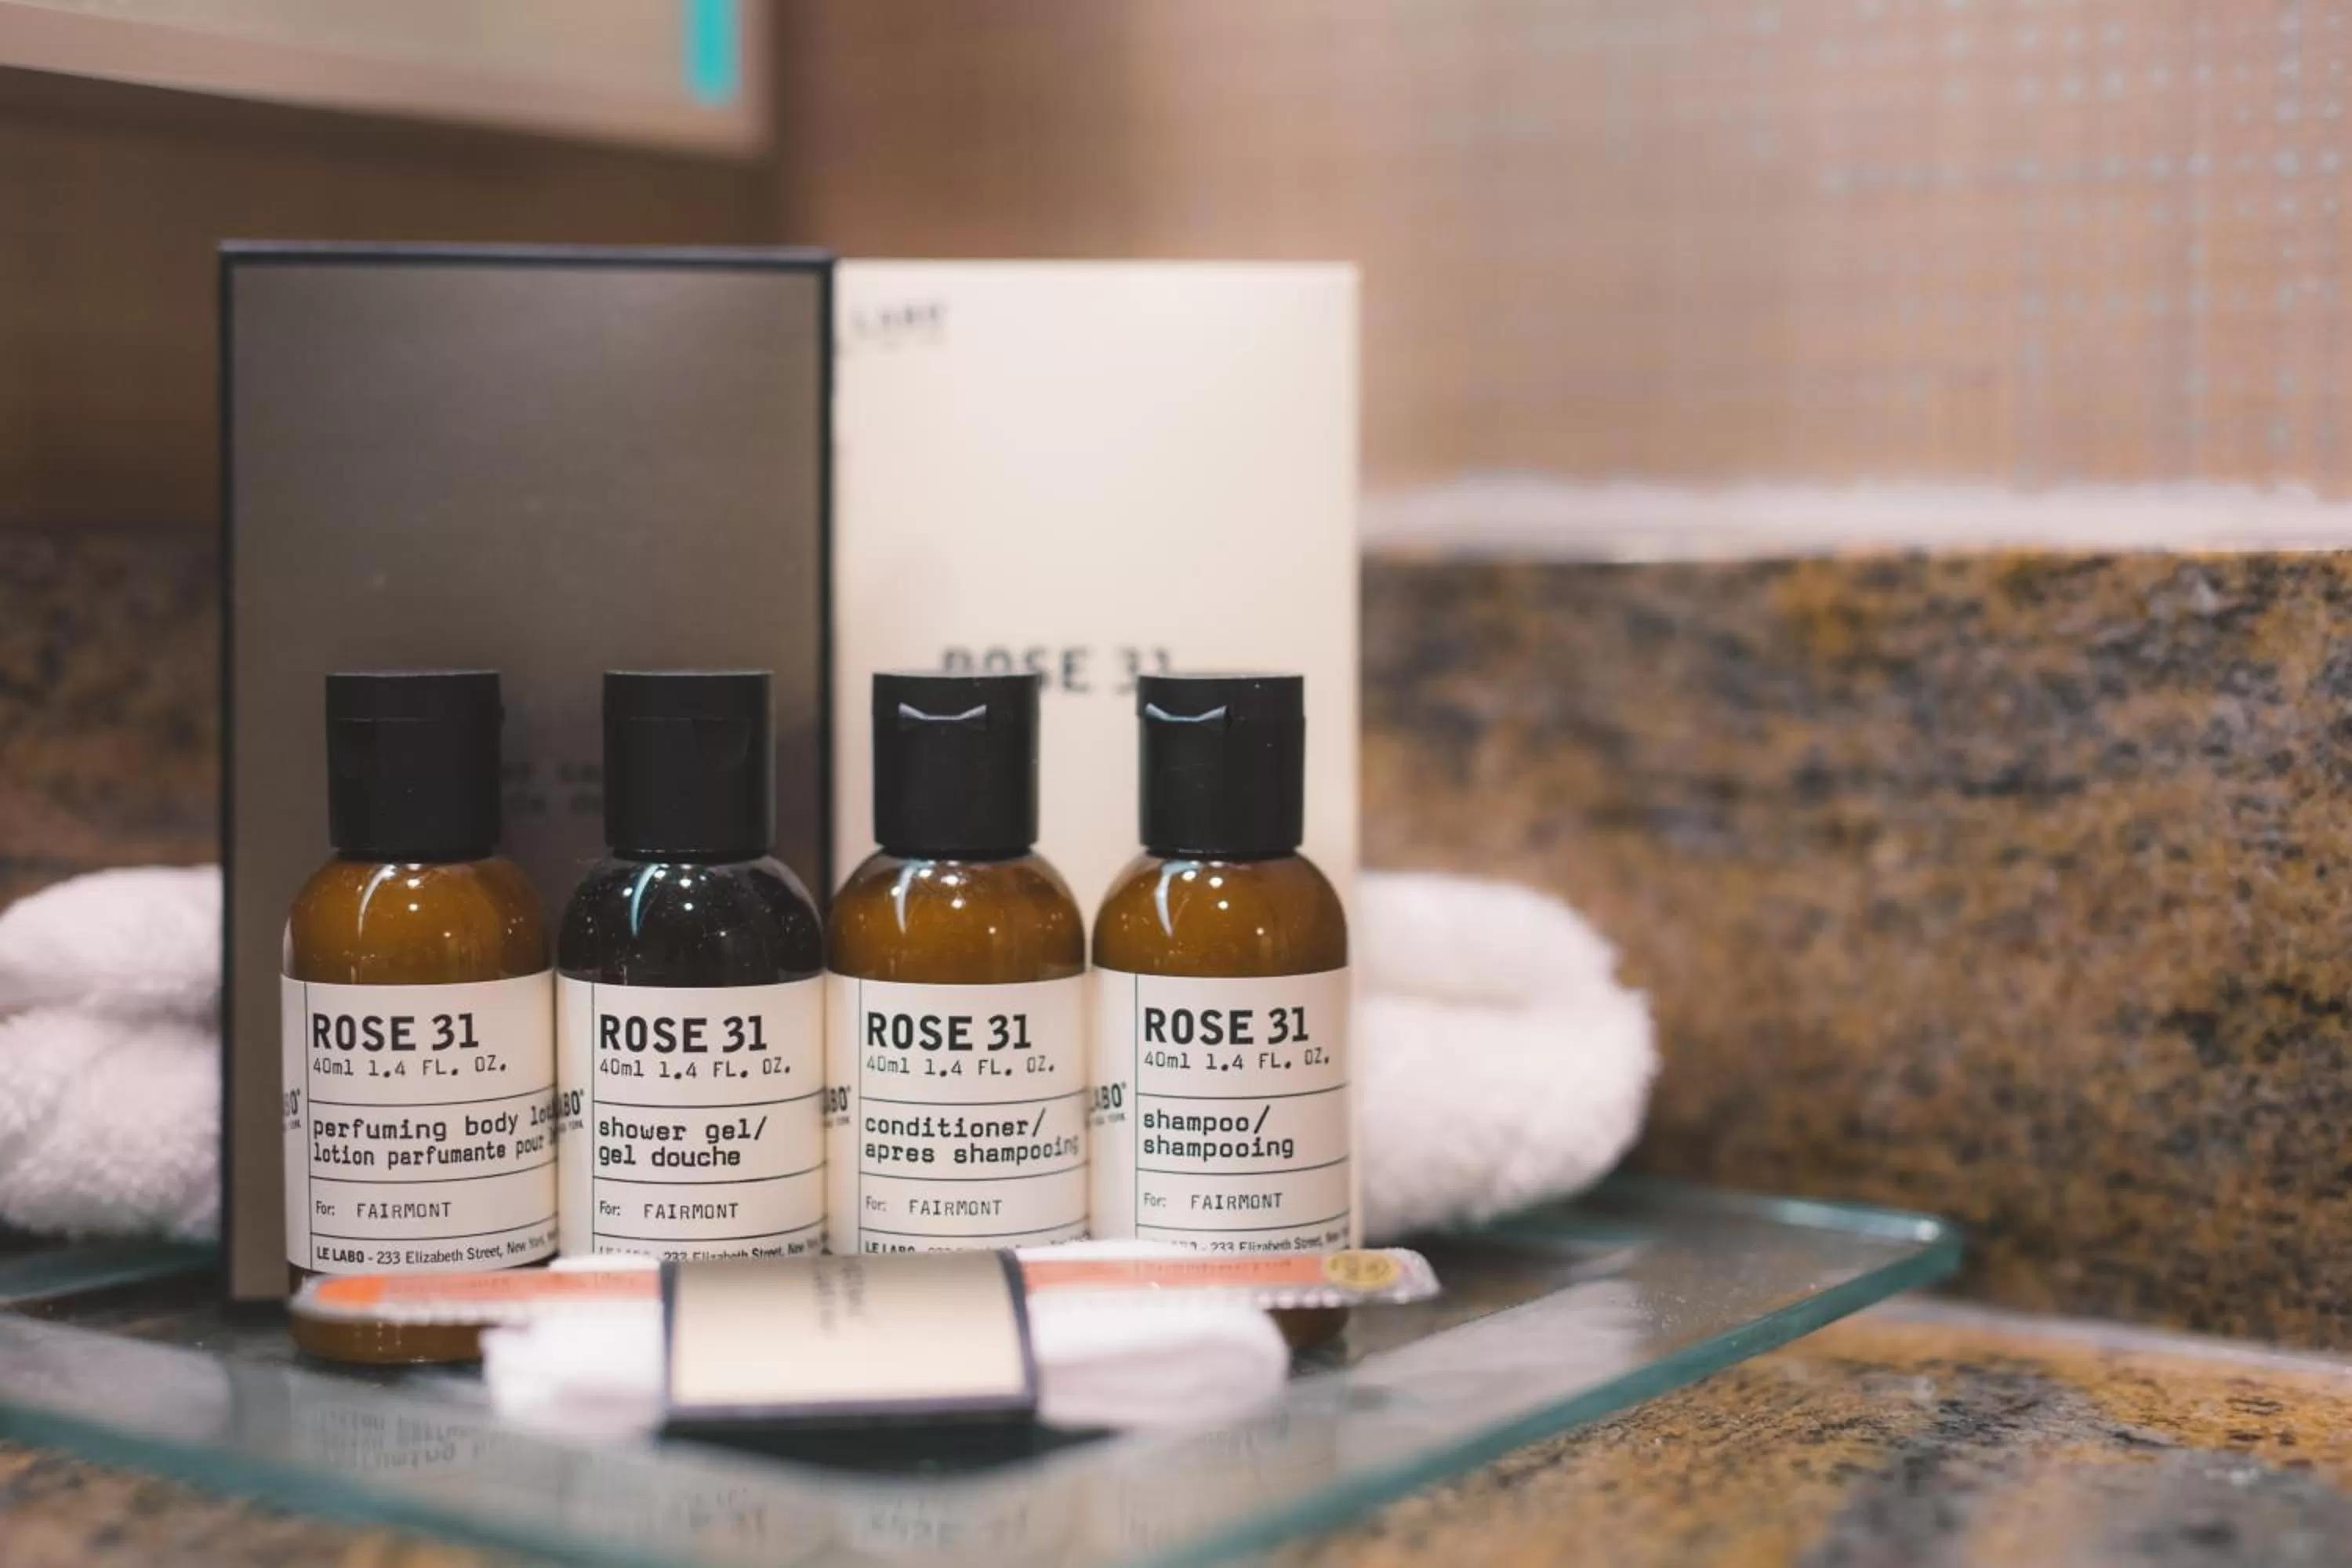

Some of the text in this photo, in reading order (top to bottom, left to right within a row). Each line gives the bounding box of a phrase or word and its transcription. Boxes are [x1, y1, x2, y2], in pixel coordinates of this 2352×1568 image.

[313, 1012, 479, 1051] ROSE 31
[601, 1014, 767, 1053] ROSE 31
[868, 1011, 1031, 1051] ROSE 31
[1145, 1007, 1308, 1045] ROSE 31
[313, 1054, 506, 1078] 40ml 1.4 FL. OZ.
[600, 1057, 790, 1079] 40ml 1.4 FL. OZ.
[866, 1055, 1054, 1077] 40ml 1.4 FL. OZ.
[1145, 1047, 1330, 1072] 40ml 1.4 FL. OZ.
[314, 1118, 447, 1142] perfuming
[465, 1112, 519, 1137] body
[600, 1116, 687, 1141] shower
[706, 1116, 767, 1143] gel/
[865, 1107, 1046, 1138] conditioner/
[1144, 1105, 1270, 1136] shampoo/
[314, 1142, 375, 1166] lotion
[388, 1144, 506, 1170] parfumante
[516, 1134, 544, 1159] pour
[600, 1145, 740, 1167] gel douche
[865, 1142, 935, 1163] apres
[1144, 1135, 1294, 1162] shampooing
[316, 1200, 452, 1219] For: FAIRMONT
[600, 1200, 739, 1219] For: FAIRMONT
[866, 1196, 1003, 1216] For: FAIRMONT
[1144, 1192, 1283, 1210] For: FAIRMONT
[316, 1245, 330, 1261] LE
[332, 1247, 364, 1264] LABO
[377, 1250, 401, 1265] 233
[405, 1248, 463, 1265] Elizabeth
[467, 1243, 503, 1261] Street,
